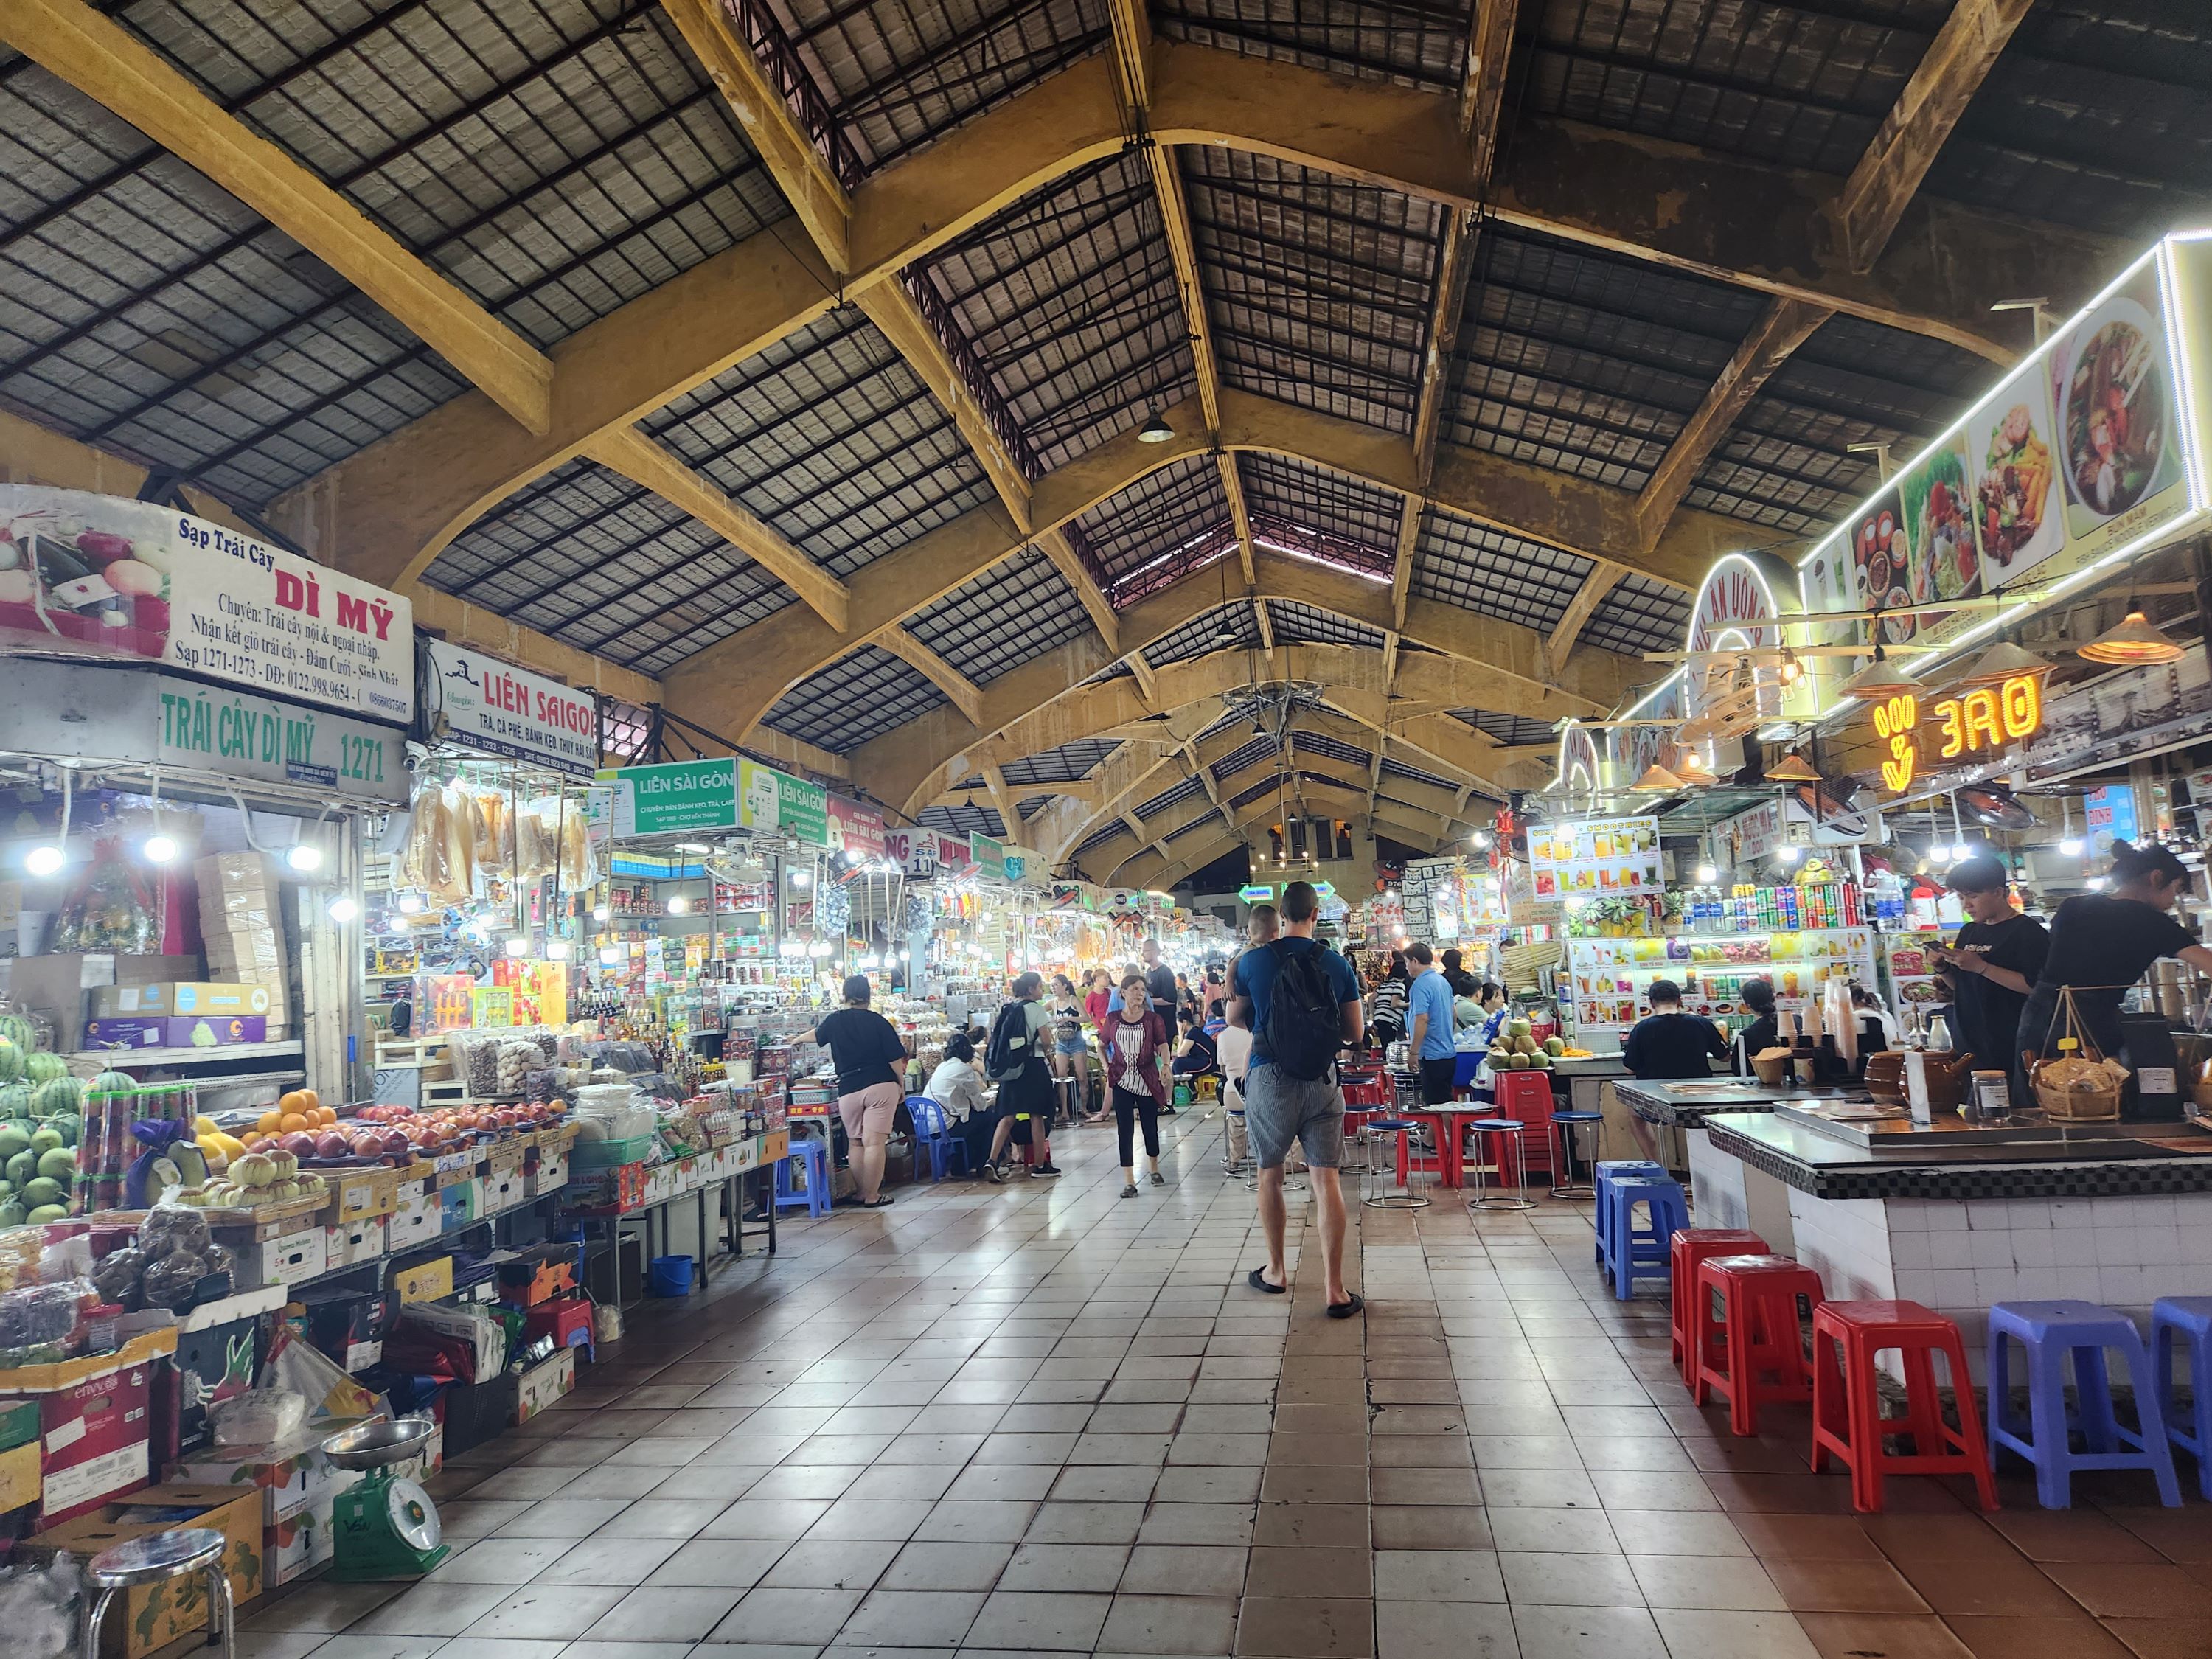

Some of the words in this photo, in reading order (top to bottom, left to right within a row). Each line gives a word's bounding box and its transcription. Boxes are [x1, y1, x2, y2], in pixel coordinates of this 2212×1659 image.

[178, 518, 209, 549] Sạp
[214, 529, 245, 559] Trái
[249, 544, 274, 572] Cây
[275, 568, 319, 619] DÌ
[337, 591, 393, 641] MỸ
[191, 613, 221, 643] Nhận
[225, 620, 241, 646] kết
[262, 637, 279, 657] trái
[282, 641, 297, 667] cây
[307, 647, 327, 670] Đám
[330, 655, 351, 678] Cưới
[264, 608, 285, 630] Trái
[287, 615, 302, 640] cây
[305, 622, 319, 644] nội
[321, 627, 329, 644] &
[333, 634, 355, 656] ngoại
[175, 640, 199, 669] Sạp
[203, 647, 256, 678] 1271-1273
[484, 672, 529, 717] LIÊN
[161, 690, 212, 753] TRÁI
[218, 698, 257, 760] CÂY
[262, 705, 281, 765] DÌ
[286, 714, 316, 764] MỸ
[340, 733, 383, 782] 1271
[639, 775, 671, 794] LIÊN
[674, 773, 697, 792] SÀI
[698, 770, 734, 789] GÒN
[779, 781, 796, 804] LIÊN
[797, 786, 810, 808] SÀI
[810, 791, 827, 814] GÒN
[1587, 819, 1652, 832] SMOOTHIES
